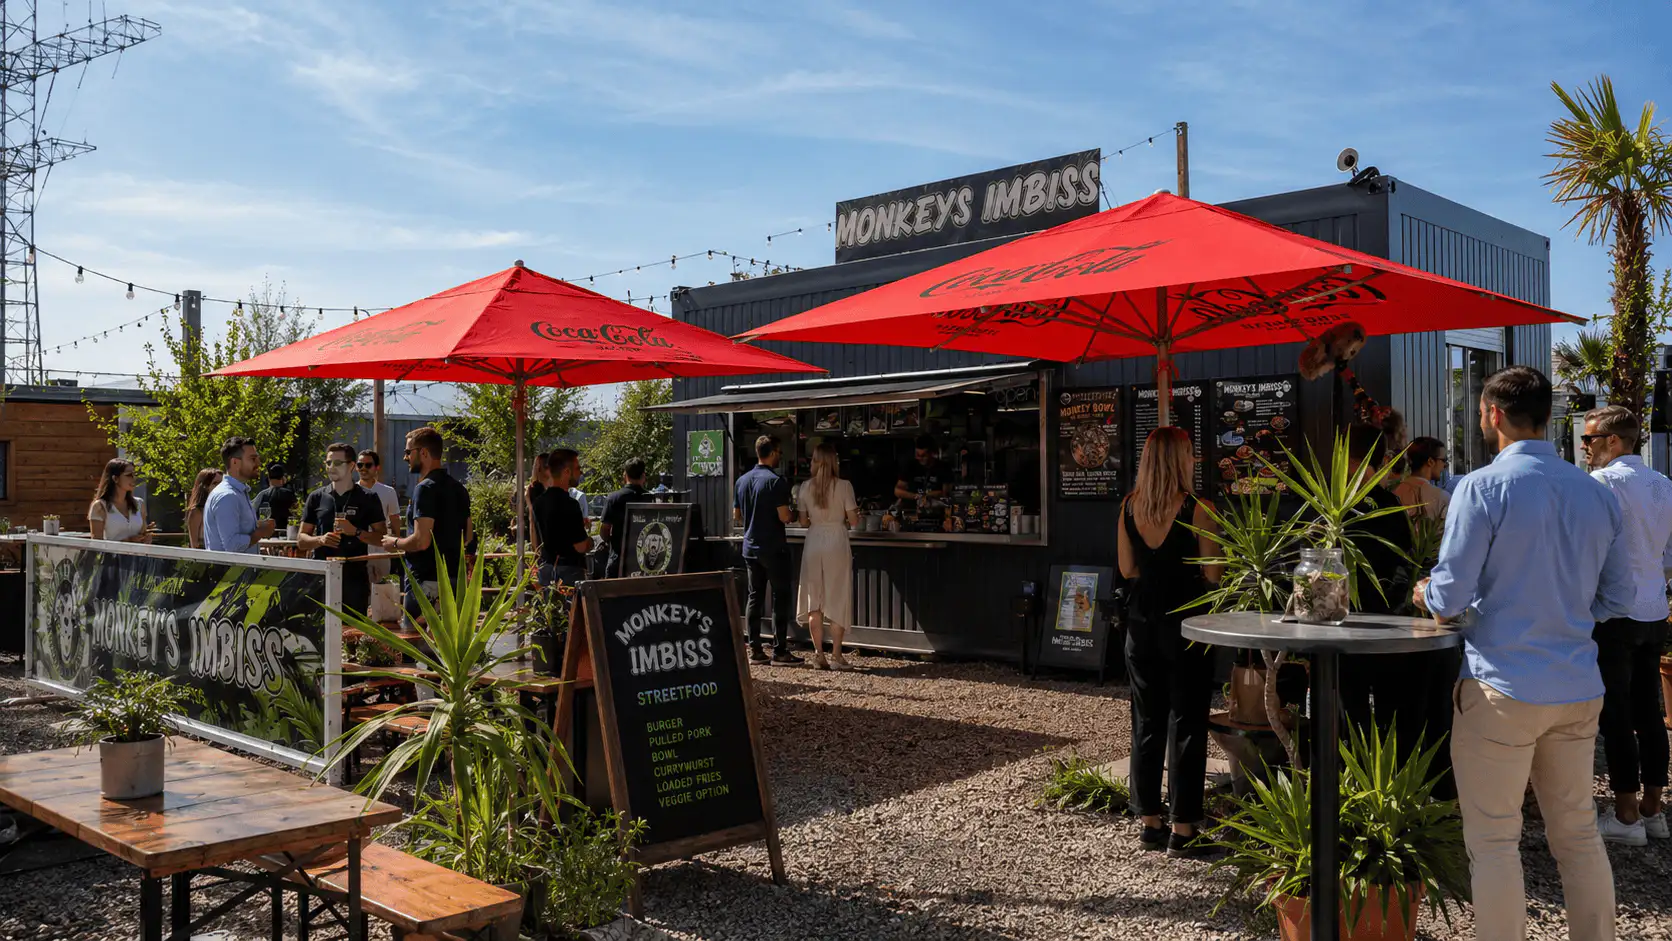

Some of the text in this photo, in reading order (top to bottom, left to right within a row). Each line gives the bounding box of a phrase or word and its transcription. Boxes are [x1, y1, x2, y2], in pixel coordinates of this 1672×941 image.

[836, 160, 1100, 250] MONKEYS IMBISS
[615, 604, 713, 645] MONKEY'S
[92, 597, 284, 696] MONKEY'S IMBISS
[629, 638, 713, 676] IMBISS
[637, 682, 718, 706] STREETFOOD
[646, 717, 683, 732] BURGER
[649, 726, 712, 747] PULLED PORK
[652, 748, 678, 762] BOWL
[654, 757, 715, 777] CURRYWURST
[656, 771, 722, 793] LOADED FRIES
[658, 784, 729, 808] VEGGIE OPTION
